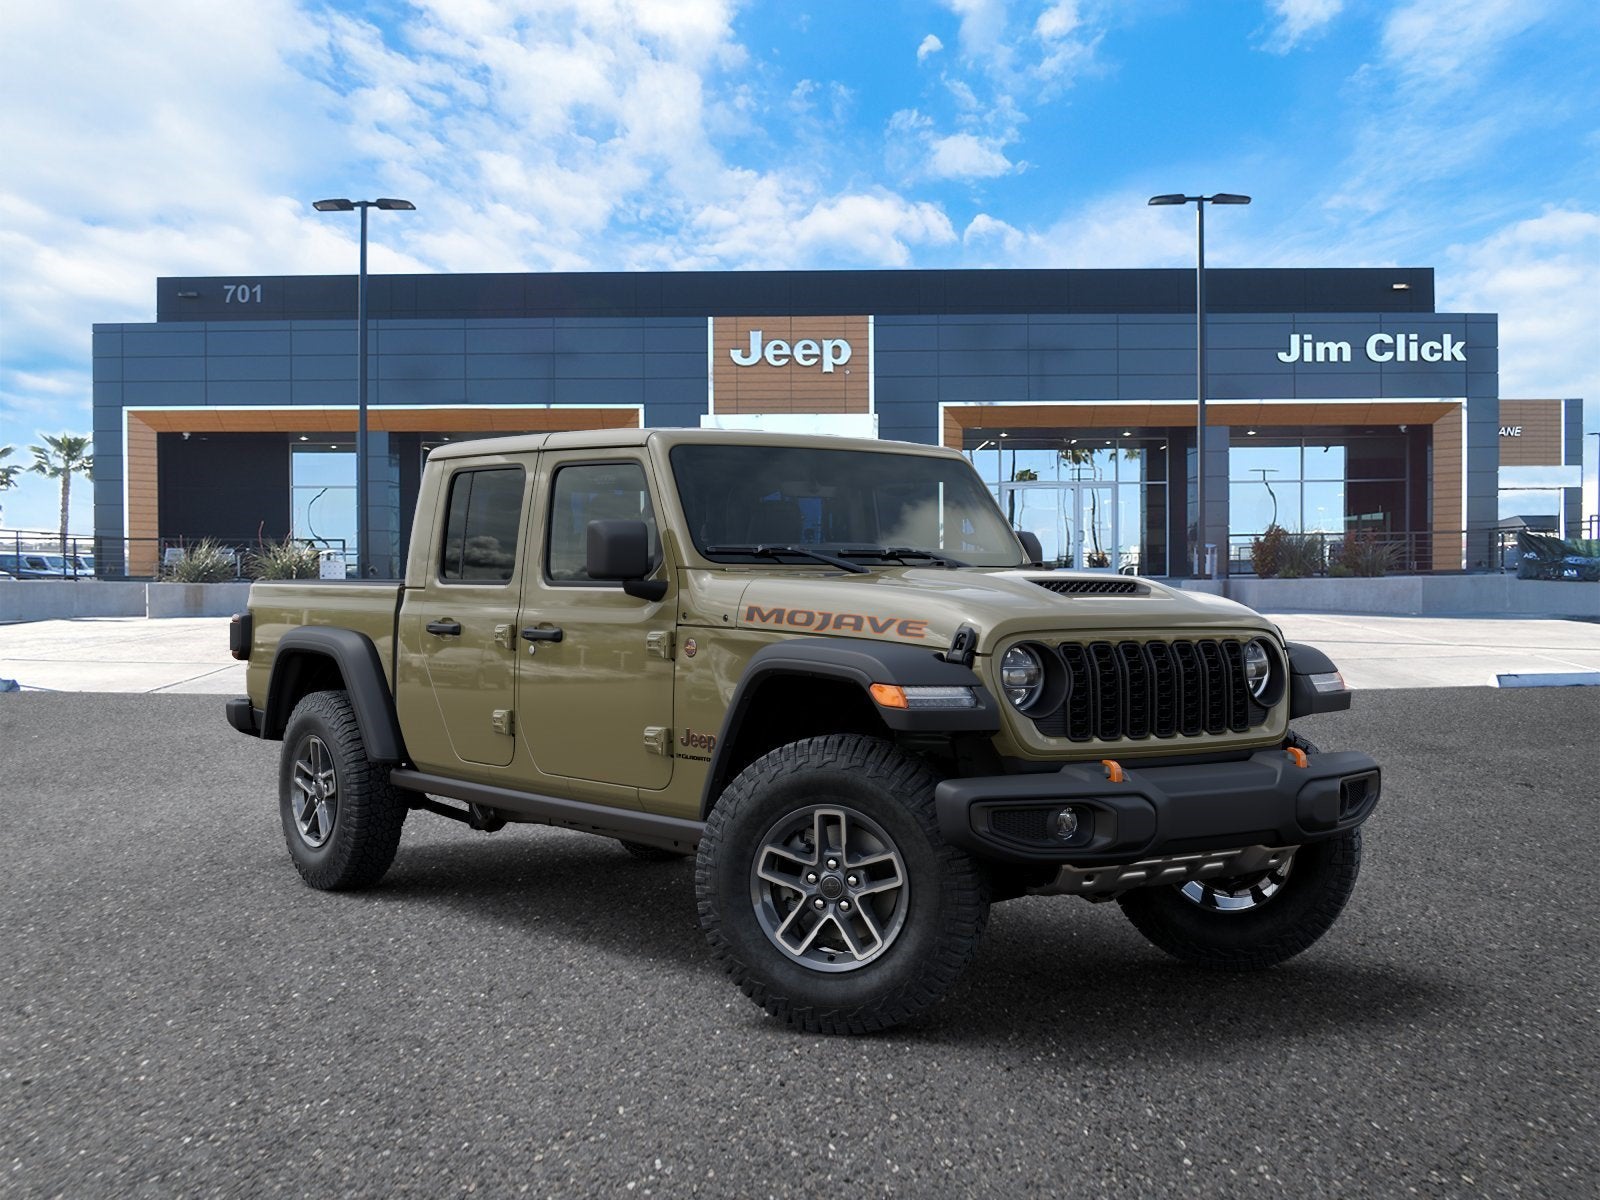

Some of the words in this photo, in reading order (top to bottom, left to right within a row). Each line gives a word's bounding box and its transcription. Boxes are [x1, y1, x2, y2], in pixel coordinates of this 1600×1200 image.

[223, 284, 262, 304] 701
[729, 330, 852, 374] Jeep
[1276, 333, 1352, 363] Jim
[1365, 332, 1467, 363] Click
[1498, 426, 1522, 437] ANE
[744, 604, 929, 639] MOJAVE
[680, 727, 717, 753] Jeep
[681, 753, 712, 762] GLADIATO
